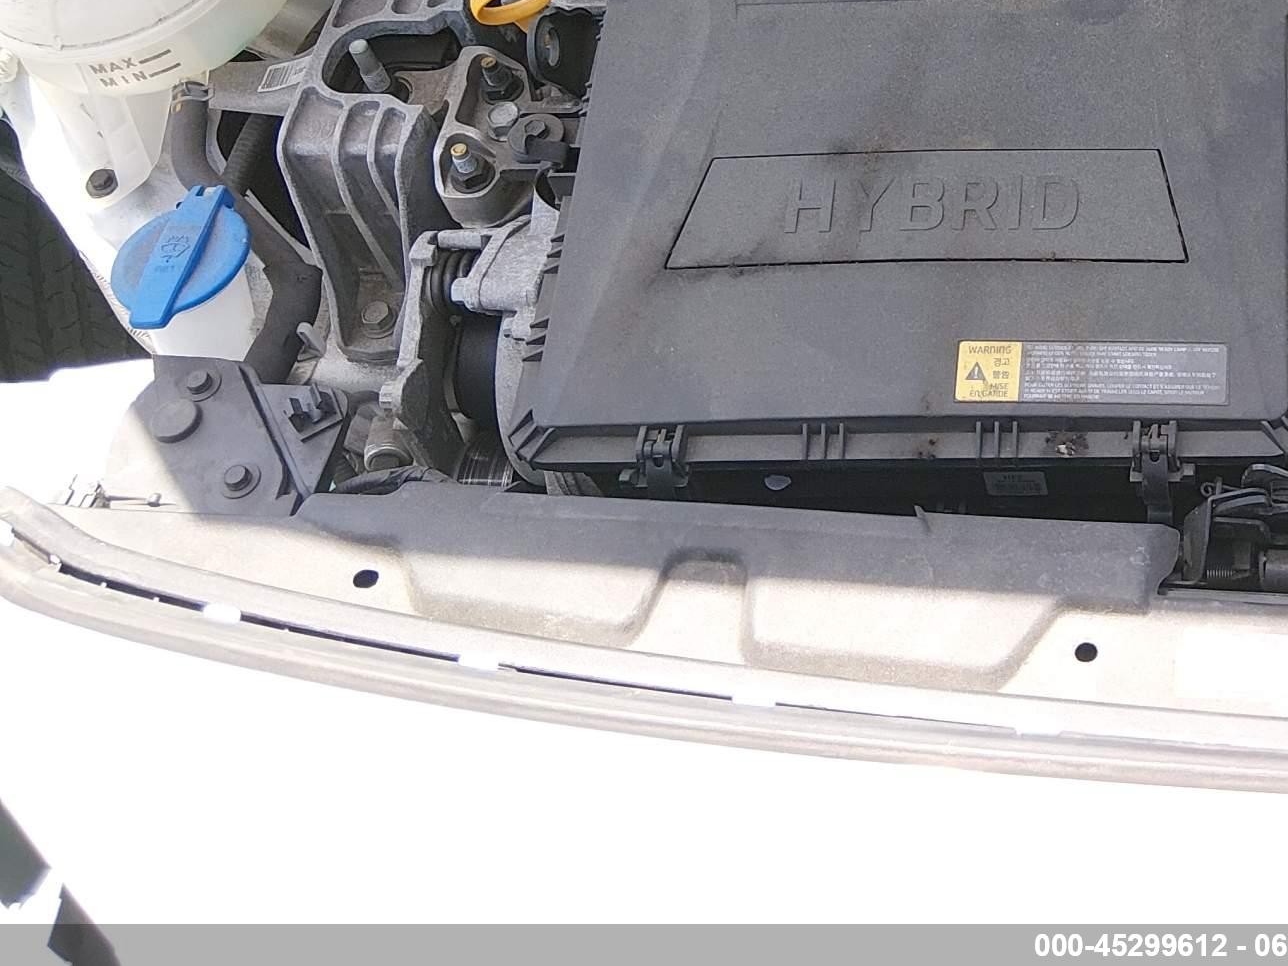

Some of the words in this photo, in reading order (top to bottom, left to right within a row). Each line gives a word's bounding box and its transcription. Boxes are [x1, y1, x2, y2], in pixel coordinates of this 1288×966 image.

[89, 57, 139, 75] MAX
[98, 70, 149, 88] MIN
[784, 178, 1081, 235] HYBRID
[968, 345, 1012, 354] WARNING
